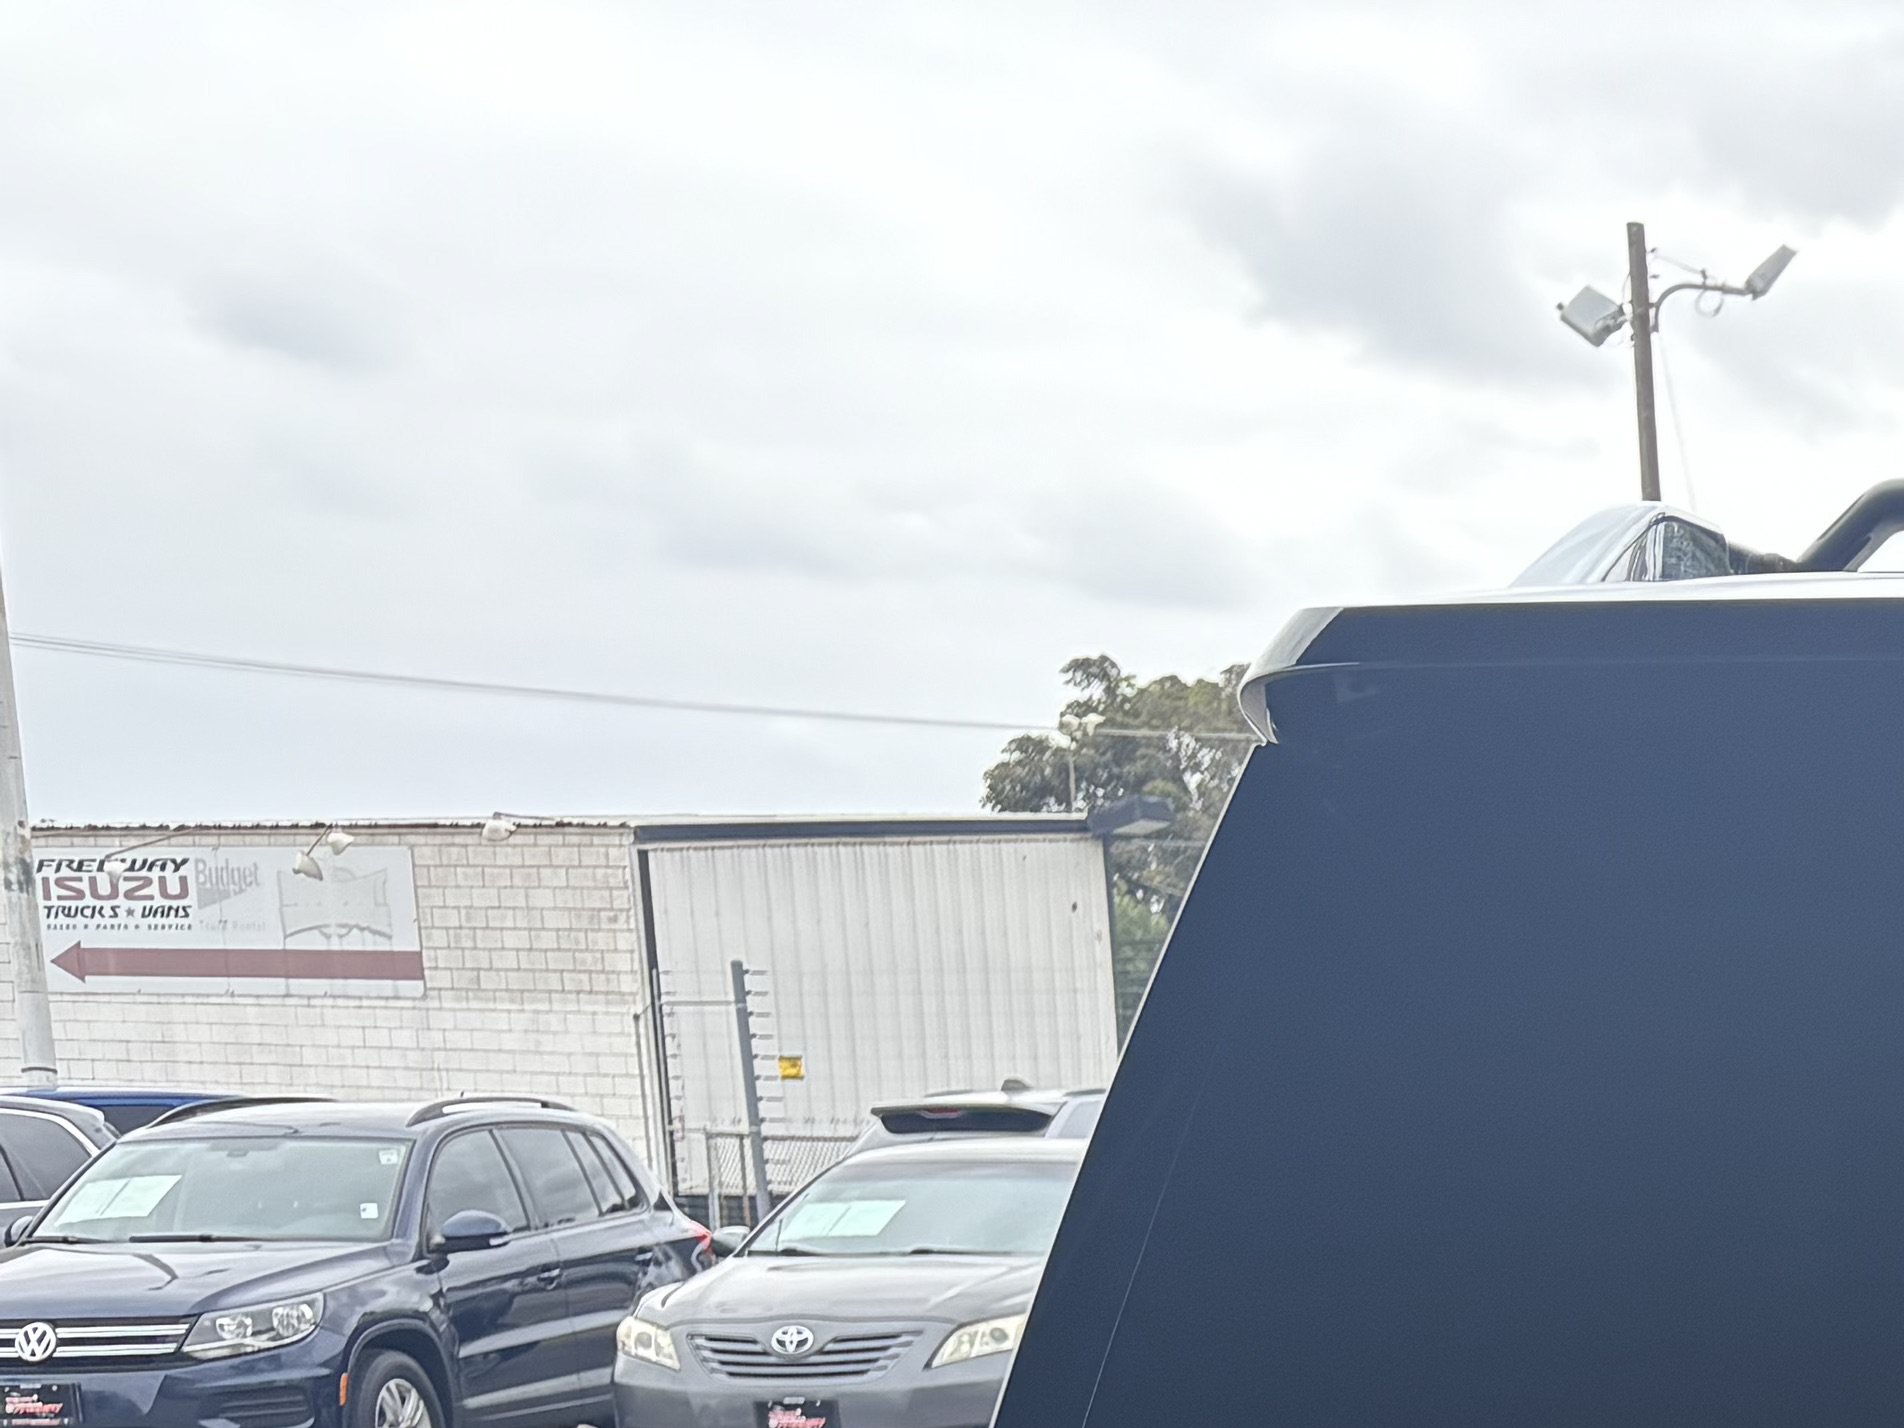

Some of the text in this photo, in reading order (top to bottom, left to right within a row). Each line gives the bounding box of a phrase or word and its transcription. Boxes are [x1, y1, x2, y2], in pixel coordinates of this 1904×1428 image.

[41, 875, 190, 901] ISUZU
[194, 858, 260, 896] Budget
[43, 905, 192, 919] TRUCKS VANS
